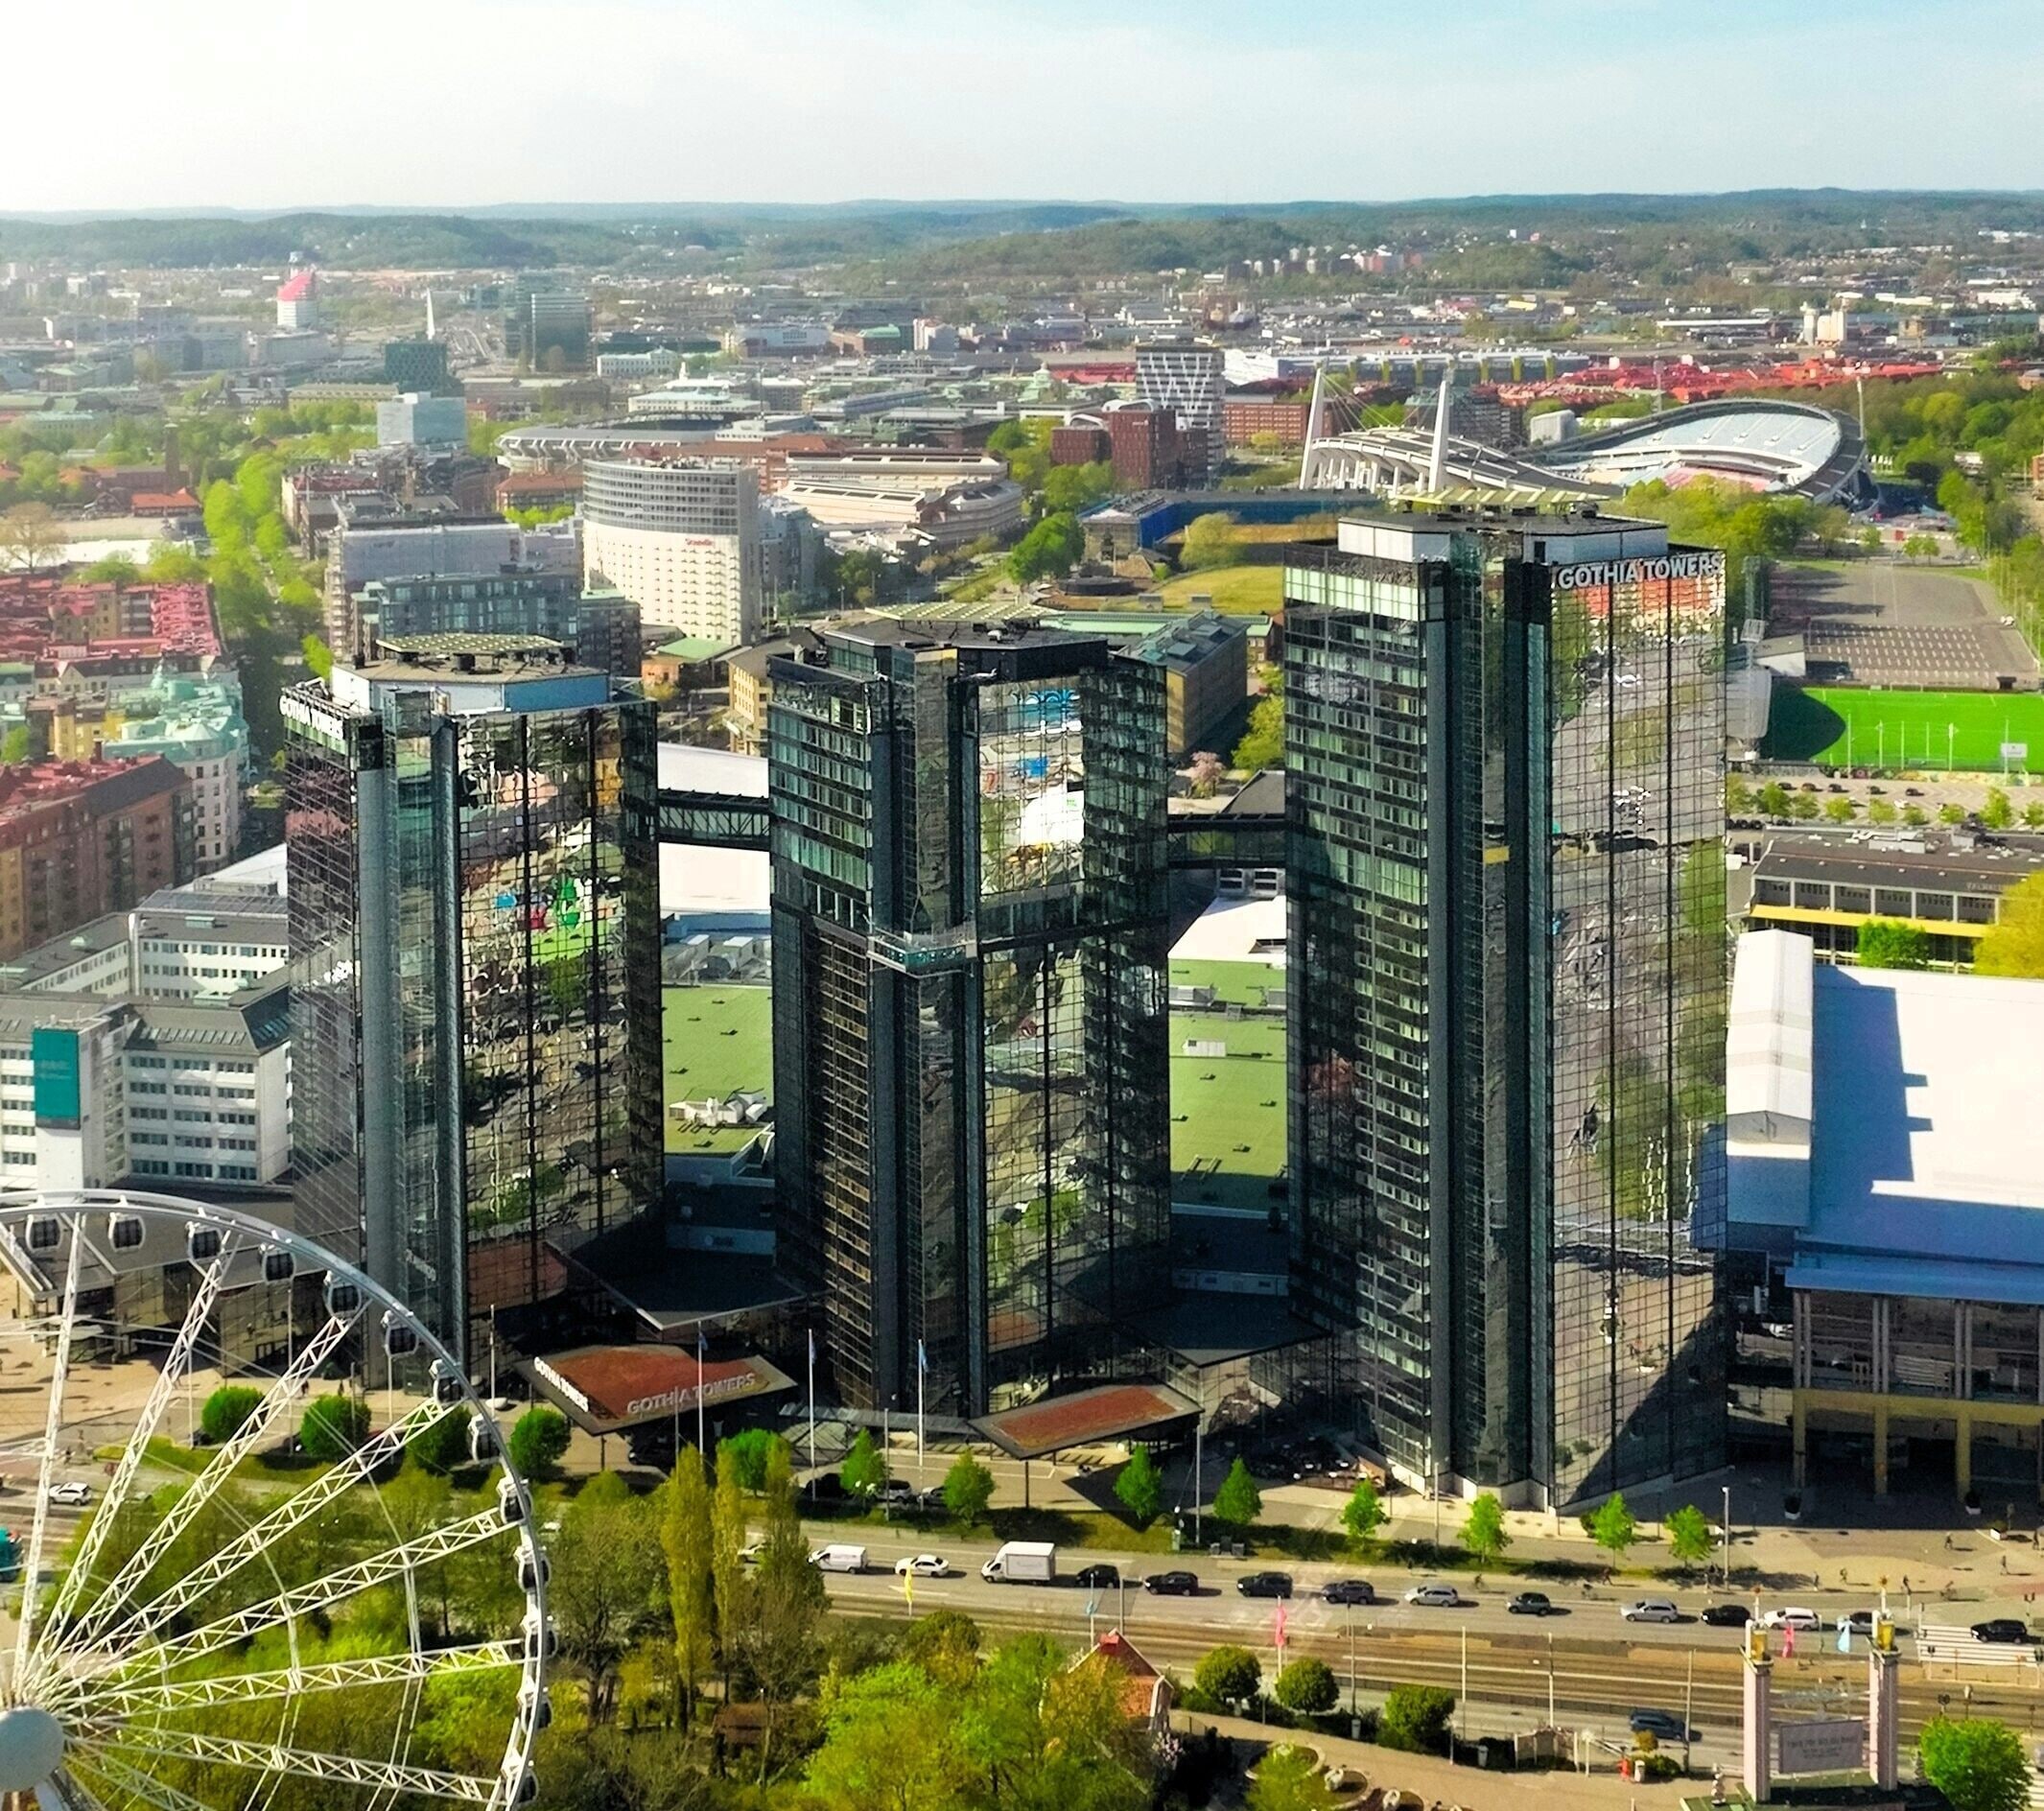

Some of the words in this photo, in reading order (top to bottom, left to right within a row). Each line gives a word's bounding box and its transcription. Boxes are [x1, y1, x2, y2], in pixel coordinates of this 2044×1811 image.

[1558, 561, 1639, 589] GOTHIA
[1643, 553, 1721, 581] TOWERS
[691, 1373, 755, 1399] TOWERS
